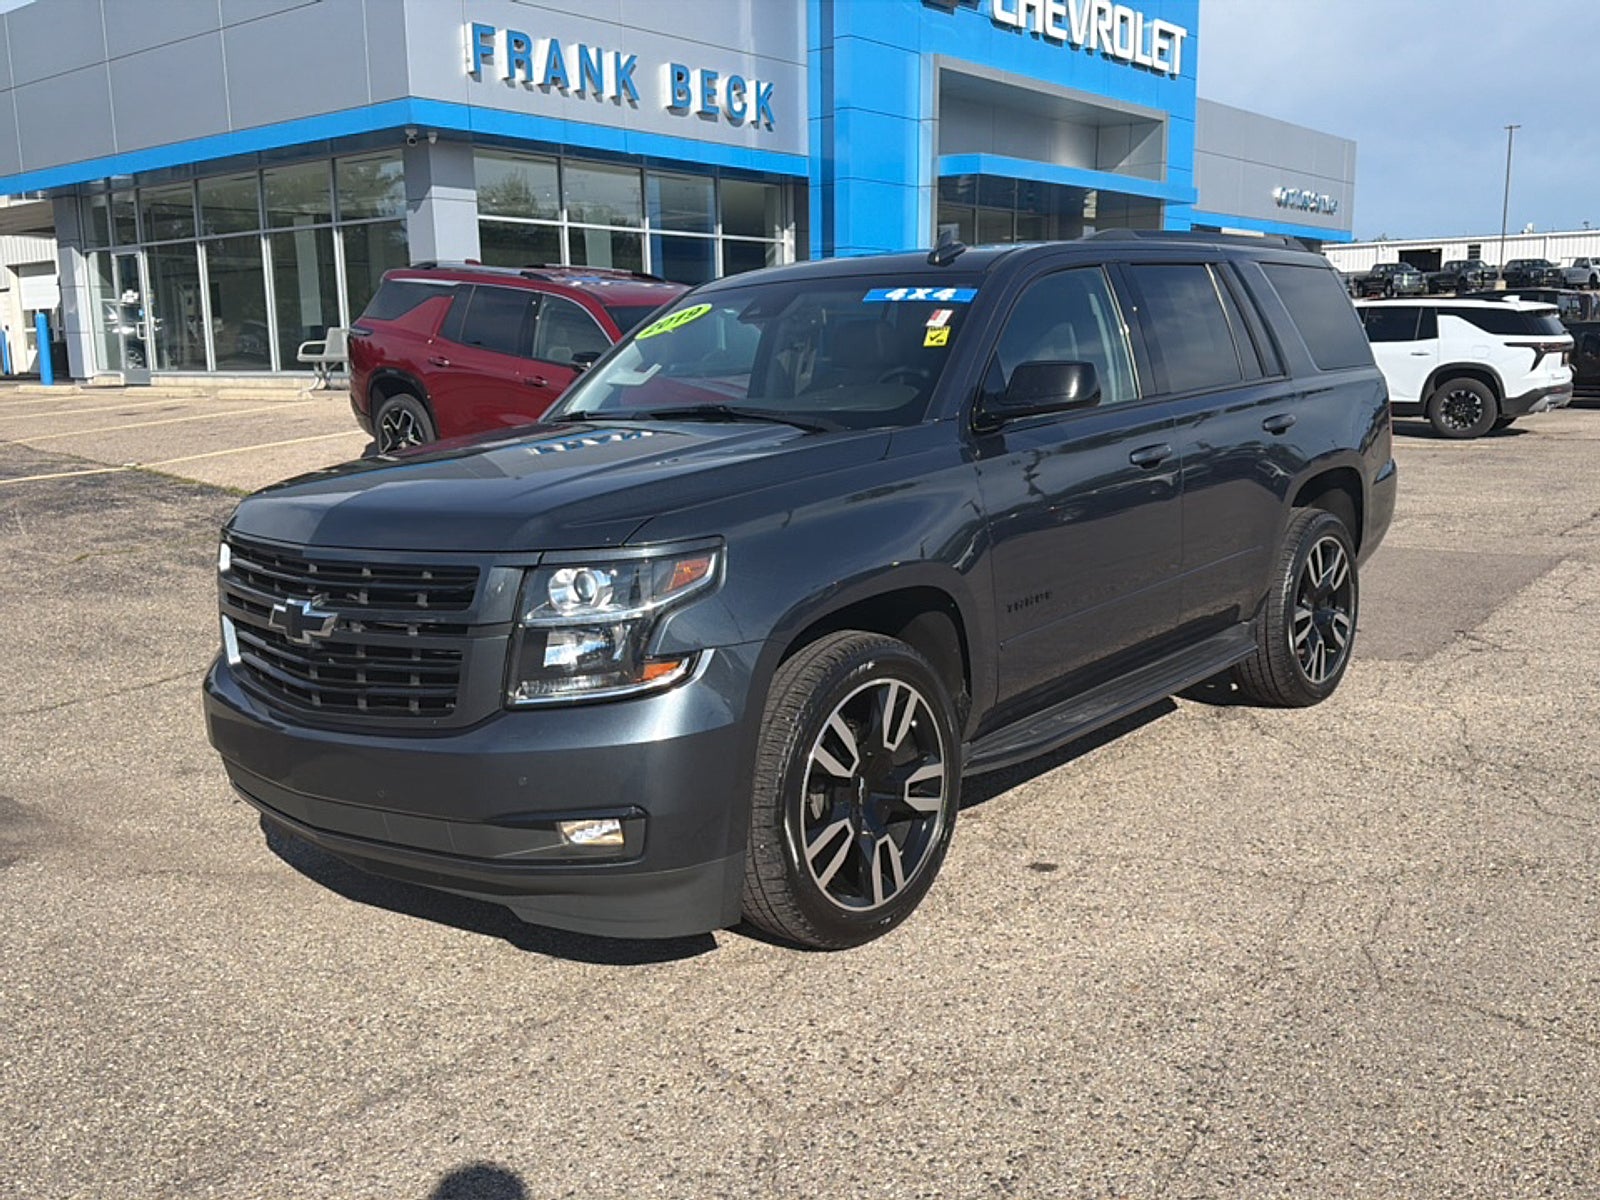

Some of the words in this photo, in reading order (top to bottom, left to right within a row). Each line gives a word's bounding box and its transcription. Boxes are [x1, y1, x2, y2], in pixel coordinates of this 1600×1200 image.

[466, 21, 641, 102] FRANK
[664, 61, 776, 125] BECK
[642, 305, 704, 336] 2019
